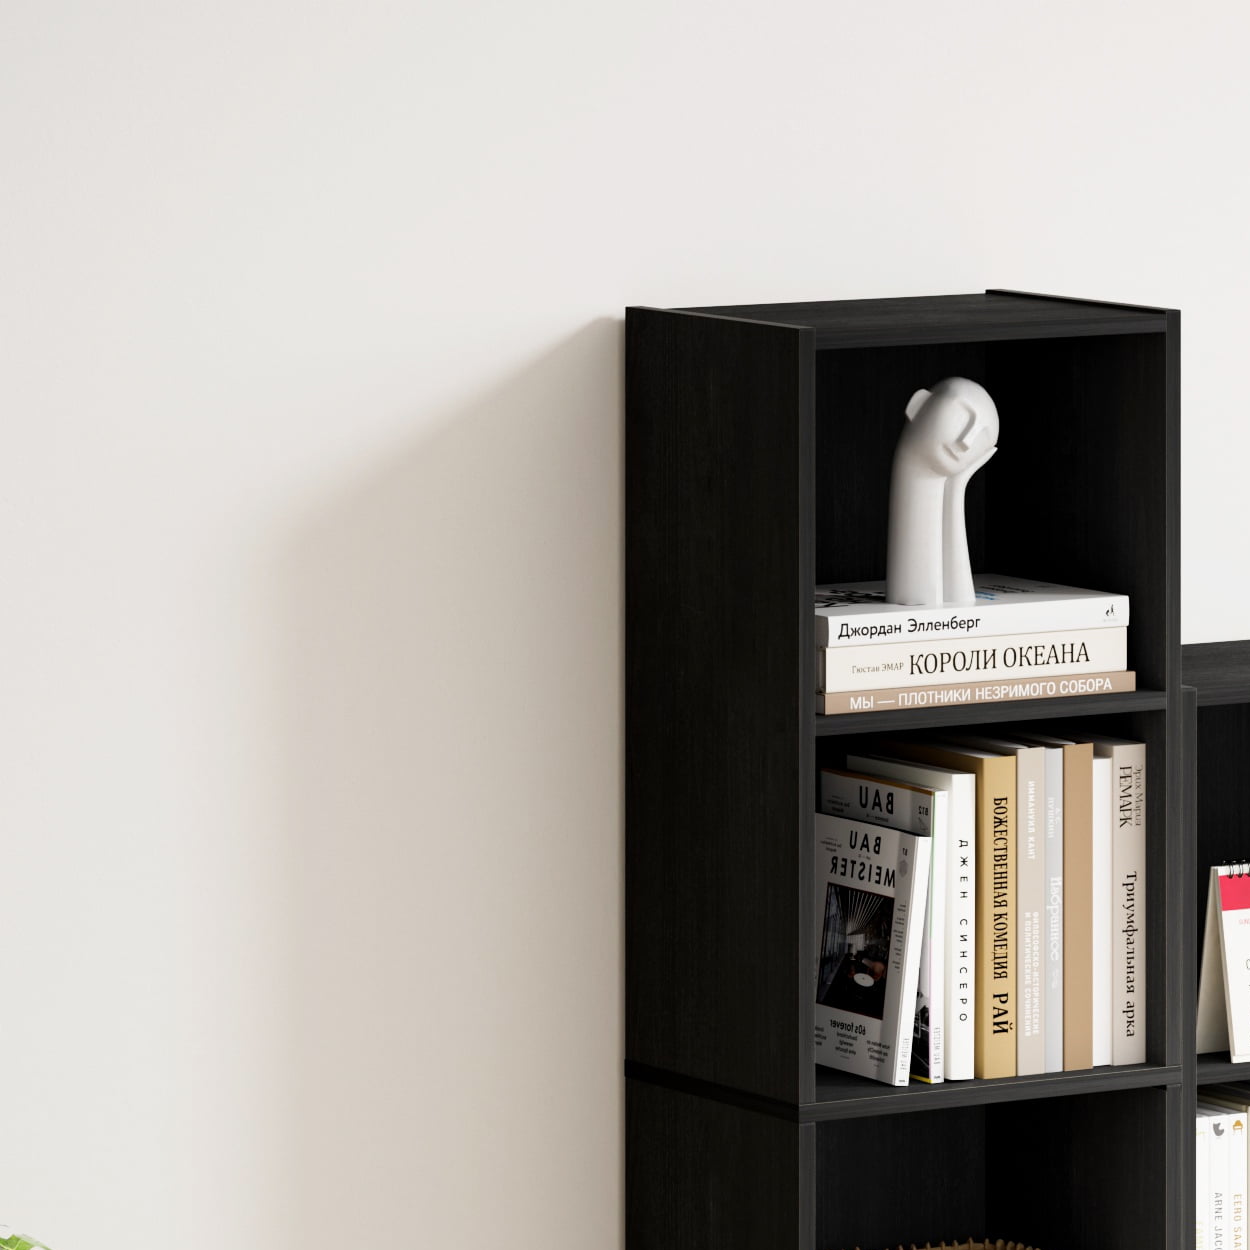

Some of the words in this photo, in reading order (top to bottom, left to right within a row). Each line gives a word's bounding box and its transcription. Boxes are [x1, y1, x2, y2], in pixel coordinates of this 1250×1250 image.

[838, 622, 902, 640] Джордан
[907, 616, 981, 633] Элленберг
[881, 661, 904, 672] ЭМАР
[909, 649, 997, 675] КОРОЛИ
[1003, 642, 1090, 668] ОКЕАНА
[850, 697, 874, 710] МЫ
[898, 689, 972, 707] ПЛОТНИКИ
[975, 682, 1056, 700] НЕЗРИМОГО
[1060, 677, 1112, 694] СОБОРА
[1028, 781, 1036, 833] ИММАНУИЛ
[1119, 766, 1132, 828] РЕМАРК
[993, 797, 1008, 909] БОЖЕСТВЕННАЯ
[1028, 837, 1036, 860] КАНТ
[959, 839, 970, 898] ДЖЕН
[992, 914, 1008, 980] КОМЕДИЯ
[1122, 871, 1138, 993] Триумфальная
[959, 918, 968, 1021] СИНСЕРО
[993, 992, 1013, 1035] РАЙ
[1123, 1001, 1135, 1037] арка
[1214, 1192, 1223, 1222] ARNE
[1233, 1194, 1242, 1222] EERO
